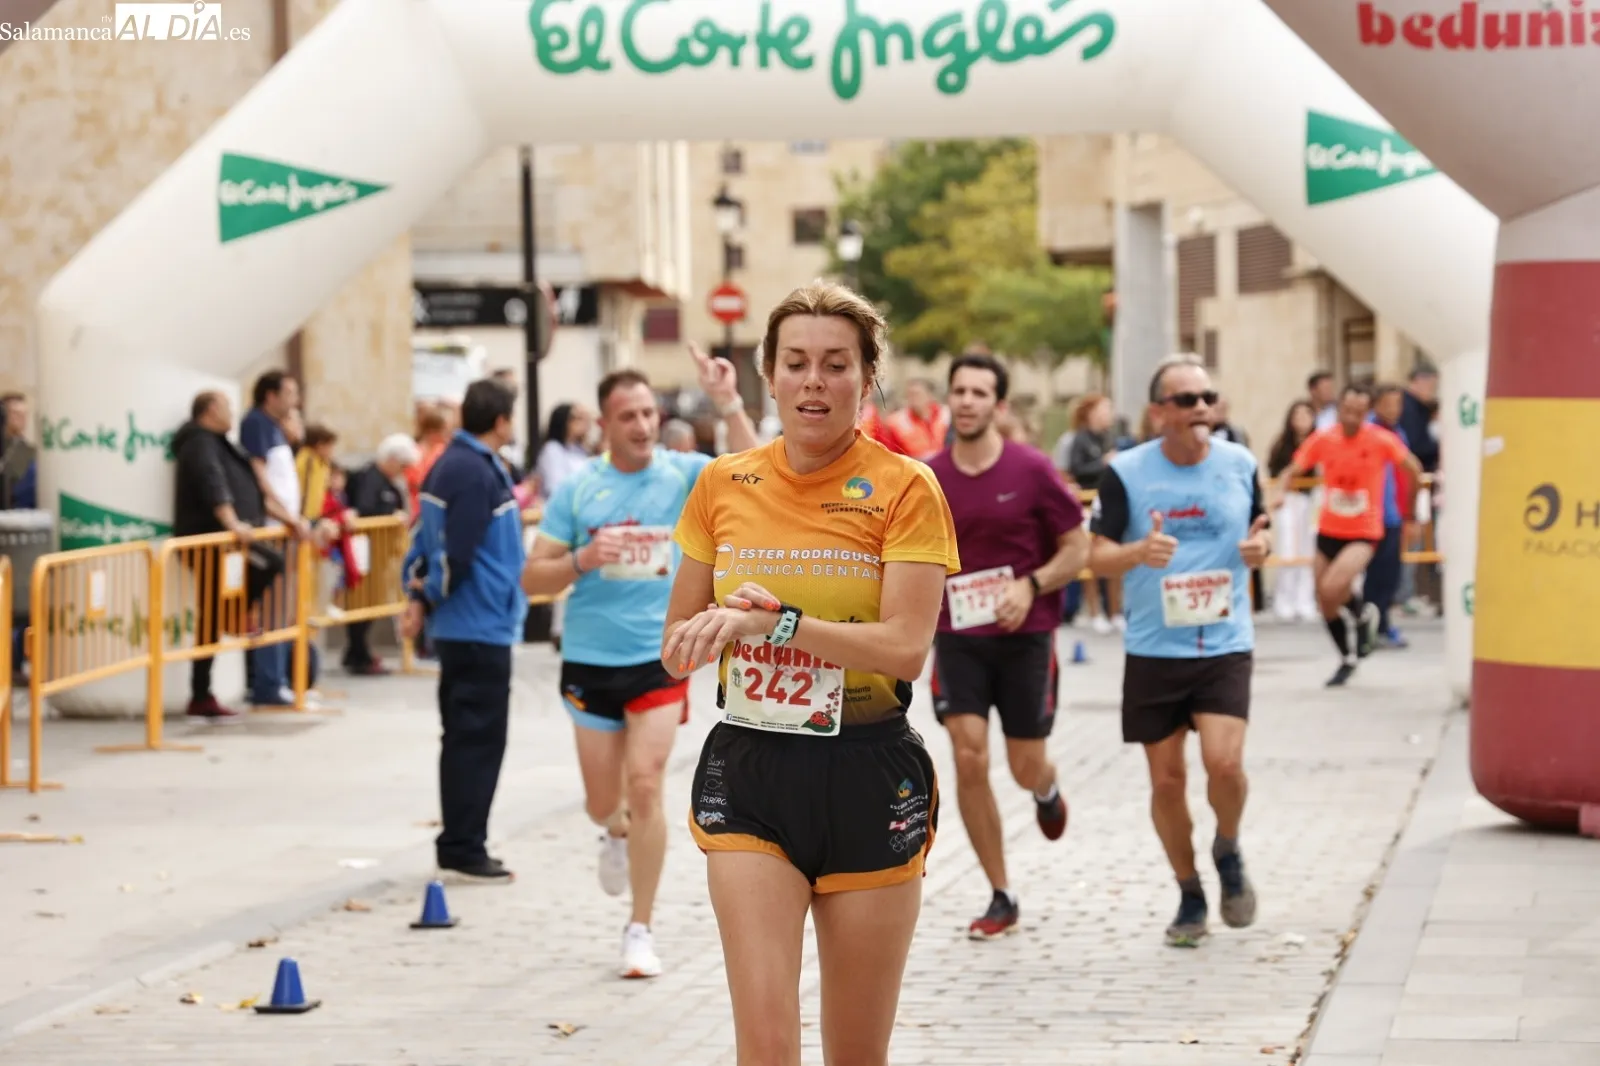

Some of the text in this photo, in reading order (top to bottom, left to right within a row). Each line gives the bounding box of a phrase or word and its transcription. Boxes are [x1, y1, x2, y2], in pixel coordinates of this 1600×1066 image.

[528, 0, 612, 75] El
[620, 0, 814, 74] Corte
[739, 548, 785, 559] ESTER
[1523, 538, 1600, 559] PALACI
[736, 562, 880, 580] CLÍNICA DENTAL
[1186, 590, 1213, 610] 37
[744, 667, 814, 706] 242
